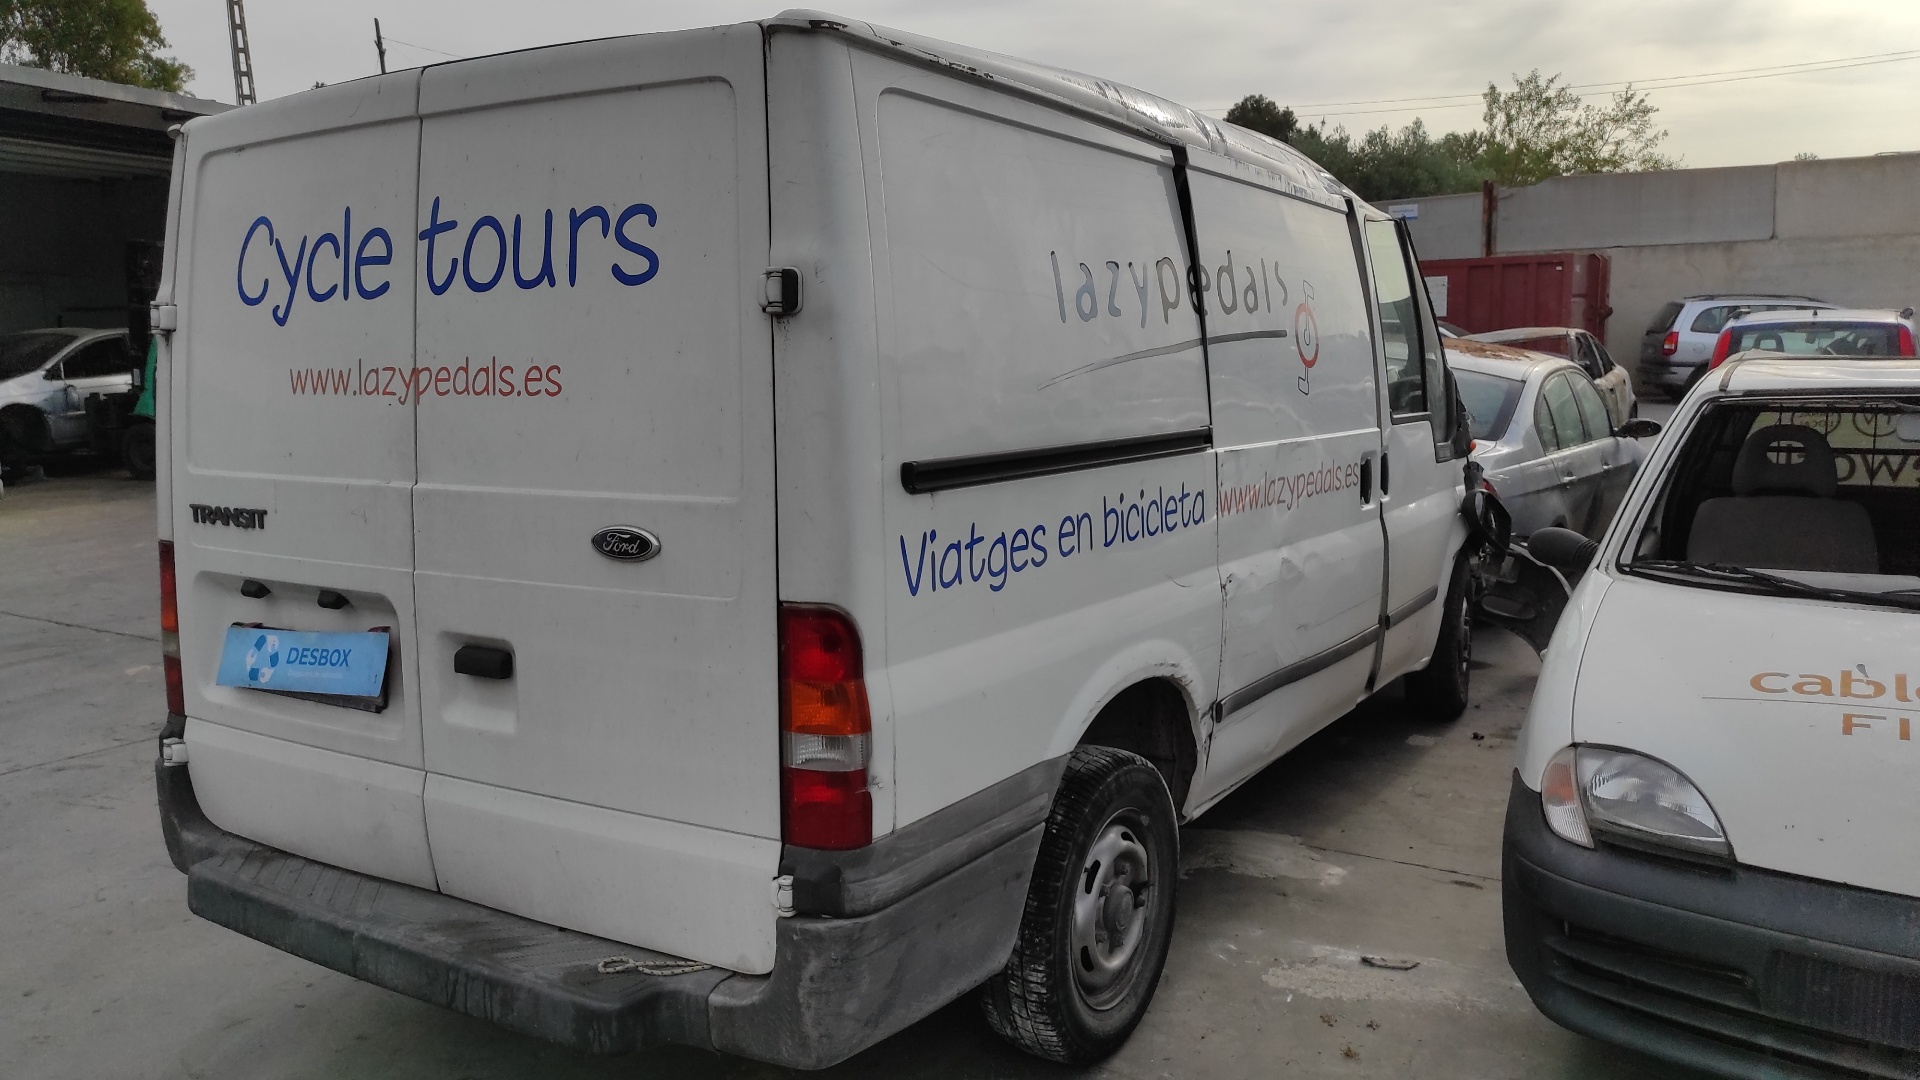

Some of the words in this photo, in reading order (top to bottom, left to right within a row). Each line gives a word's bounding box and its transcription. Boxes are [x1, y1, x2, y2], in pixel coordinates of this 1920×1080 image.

[237, 206, 393, 326] Cycle
[419, 196, 660, 295] tours
[1051, 250, 1288, 329] lazypedals
[290, 357, 562, 405] www.lazypedals.es
[1219, 459, 1359, 519] www.lazypedals.es
[189, 504, 268, 529] TRANSIT
[900, 523, 1047, 596] Viatges
[1058, 512, 1094, 557] en
[1103, 482, 1205, 548] bicicleta
[286, 647, 352, 668] DESBOX
[1750, 670, 1920, 702] cabl
